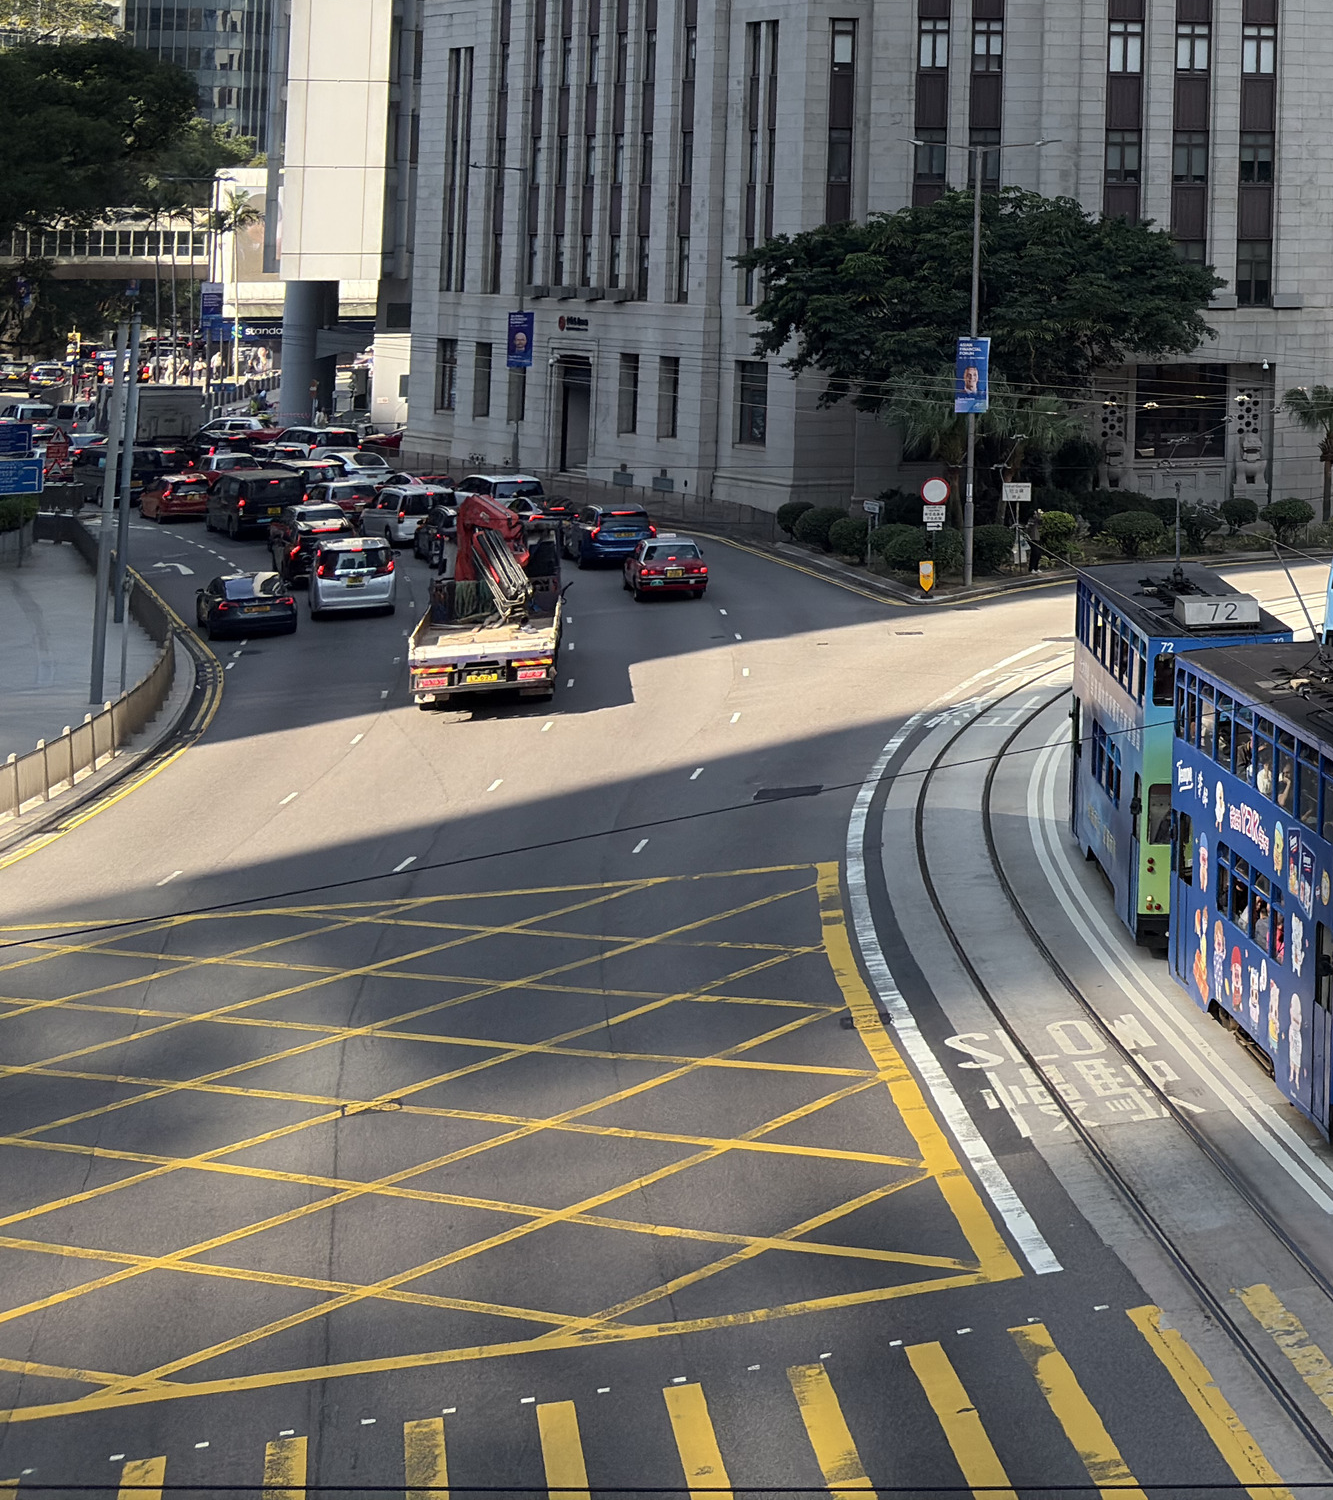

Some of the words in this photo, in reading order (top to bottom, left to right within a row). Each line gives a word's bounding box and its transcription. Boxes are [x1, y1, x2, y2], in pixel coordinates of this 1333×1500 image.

[1207, 602, 1238, 621] 72
[1160, 642, 1174, 653] 72
[944, 1013, 1157, 1069] SLOW
